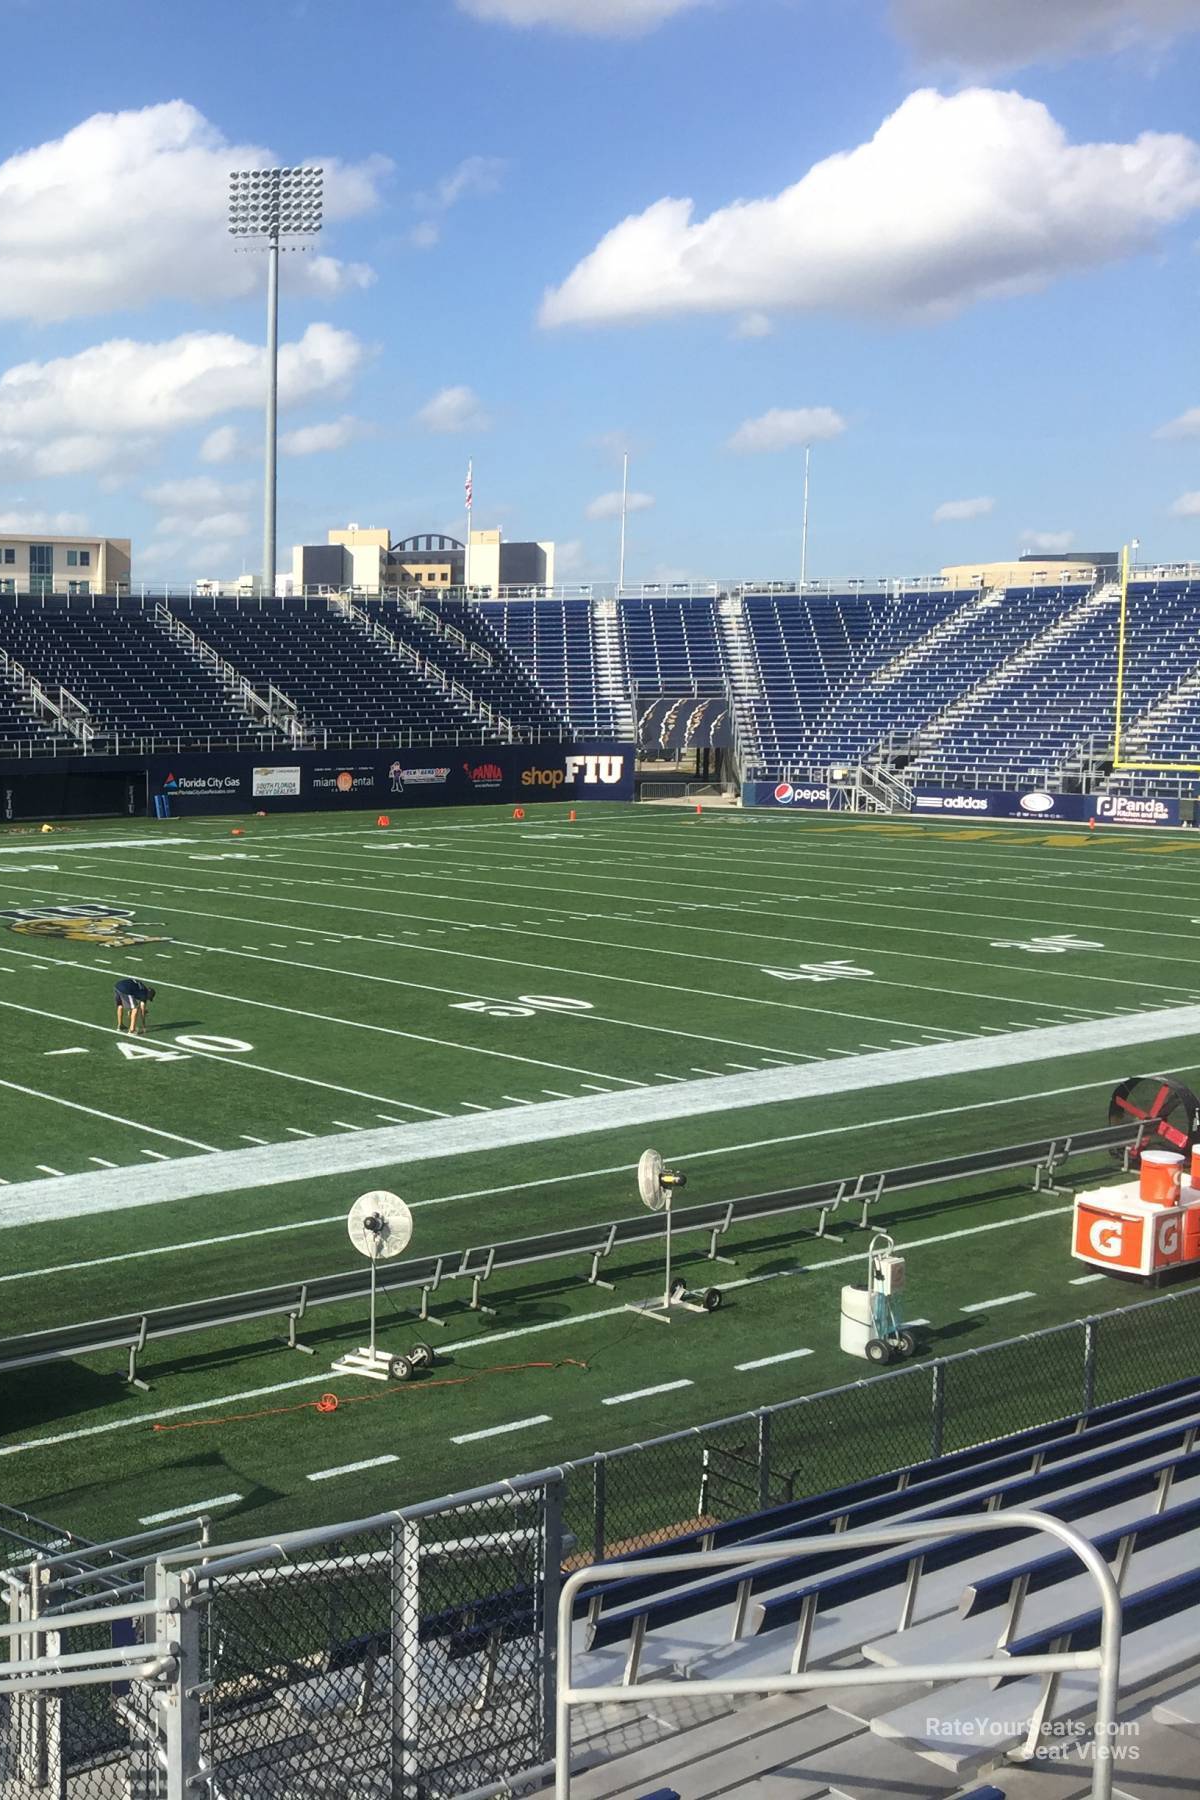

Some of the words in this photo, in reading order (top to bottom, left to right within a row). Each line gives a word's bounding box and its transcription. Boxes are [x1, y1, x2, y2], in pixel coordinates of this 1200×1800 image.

[178, 777, 206, 788] Florida
[207, 777, 223, 789] City
[224, 776, 241, 787] Gas
[794, 787, 830, 803] pepsi
[943, 796, 988, 810] adidas
[1117, 797, 1164, 813] Panda
[448, 995, 595, 1017] 50
[116, 1034, 255, 1062] 40
[1089, 1219, 1124, 1258] G
[1158, 1216, 1178, 1256] G
